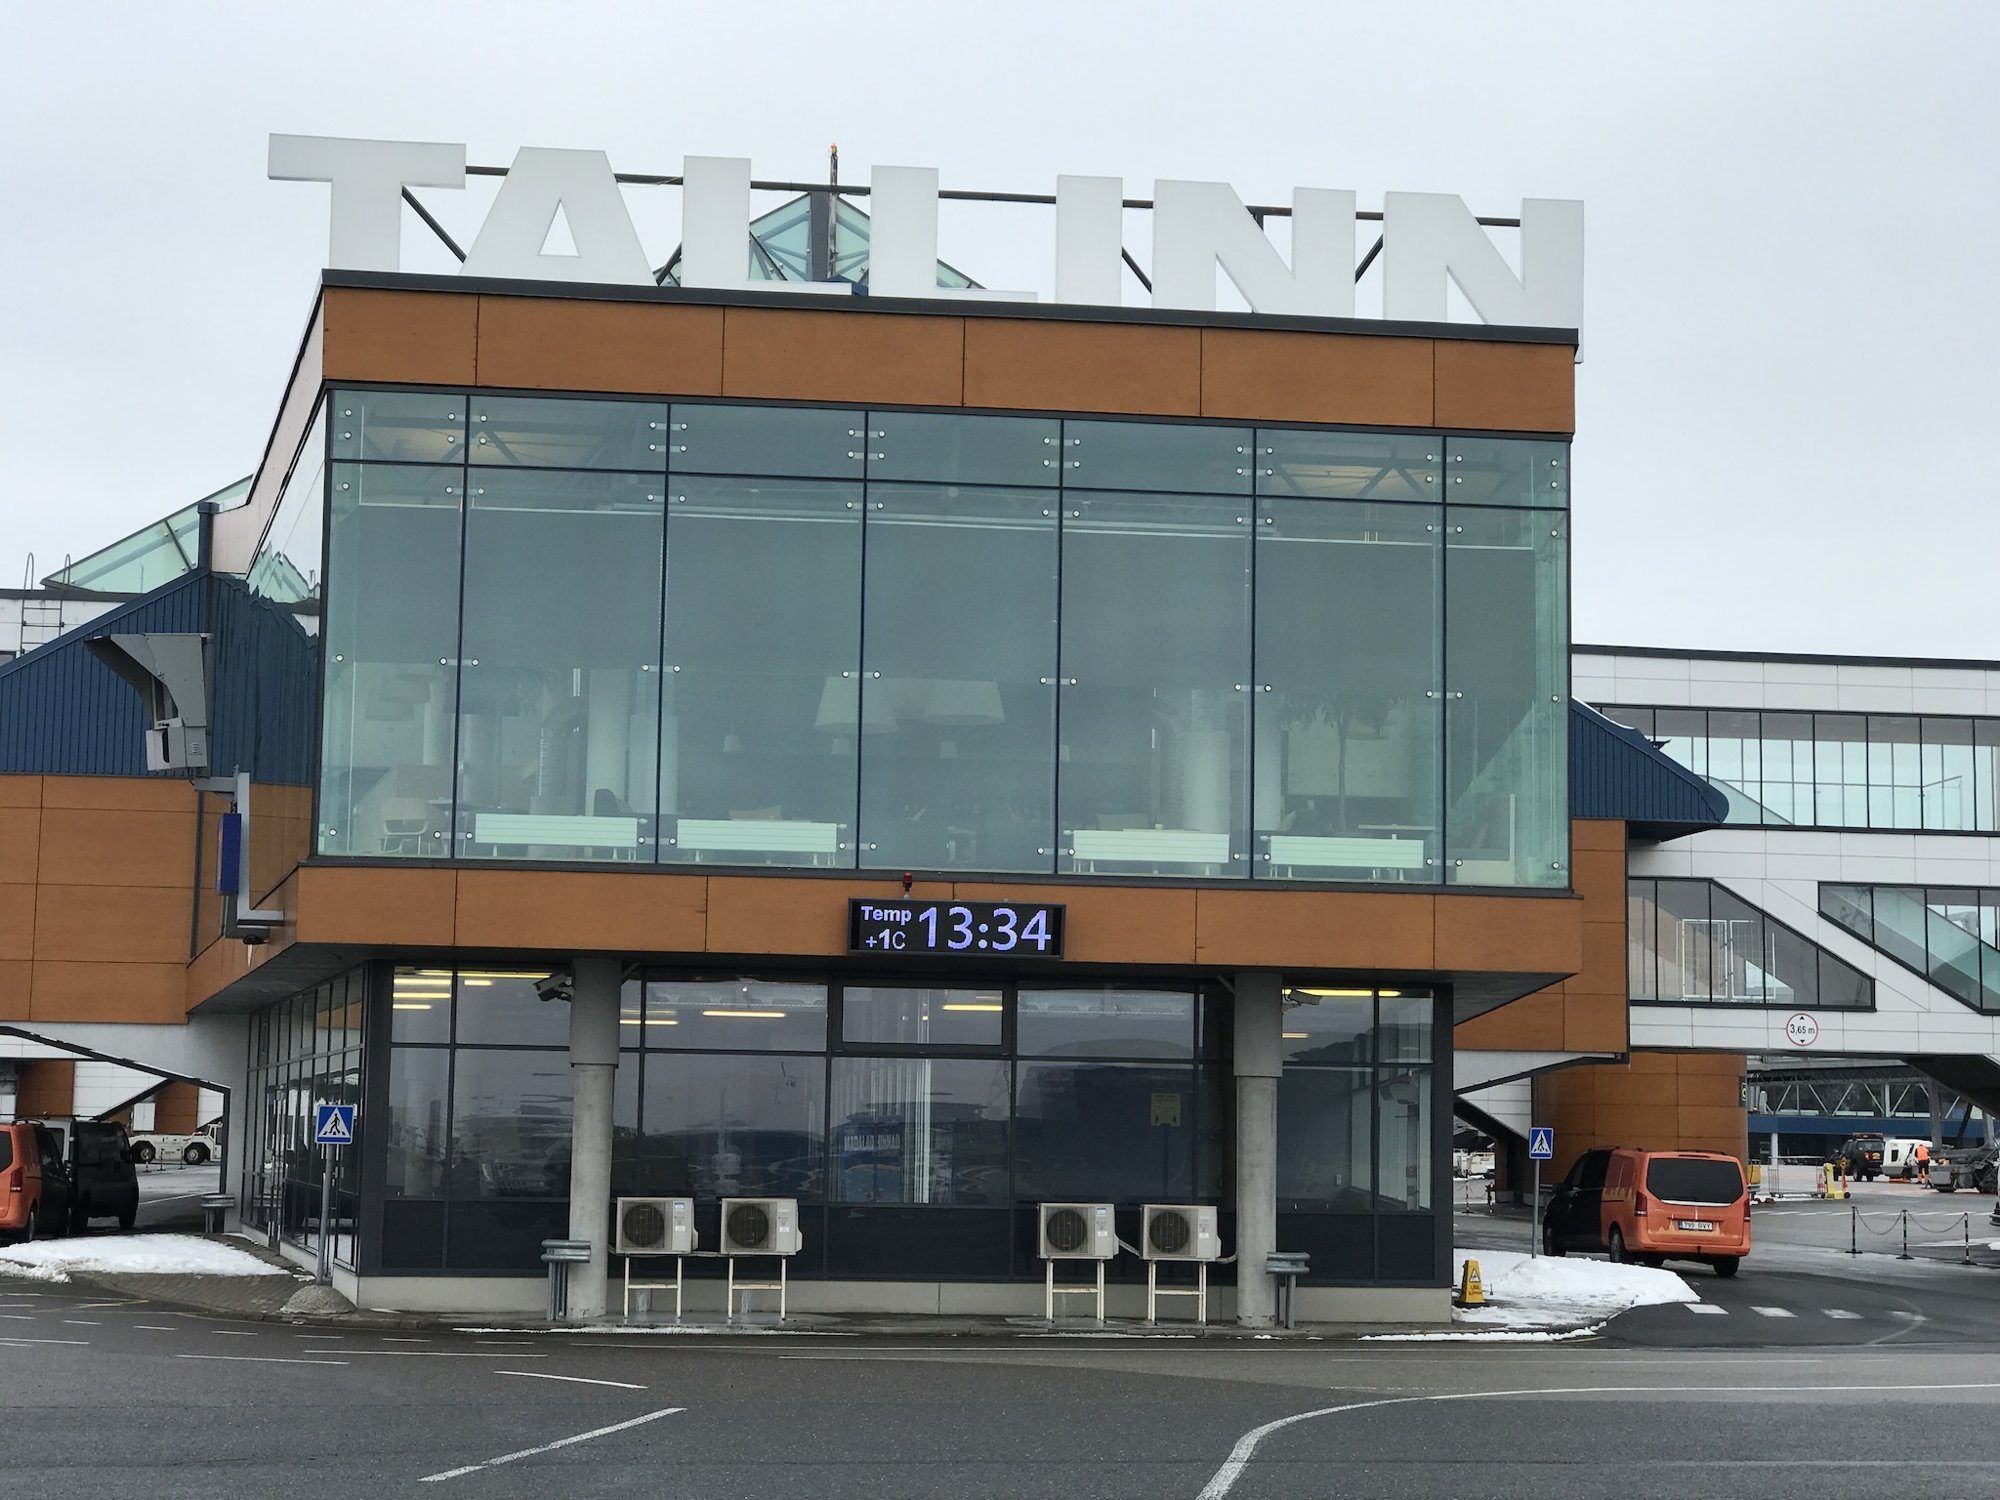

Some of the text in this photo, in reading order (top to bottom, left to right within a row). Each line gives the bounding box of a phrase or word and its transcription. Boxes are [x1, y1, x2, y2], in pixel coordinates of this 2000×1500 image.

[268, 133, 1585, 362] TALLINN
[860, 905, 912, 925] Temp
[865, 928, 906, 950] +1C
[918, 905, 1052, 951] 13:34
[1790, 1023, 1807, 1035] 3,65
